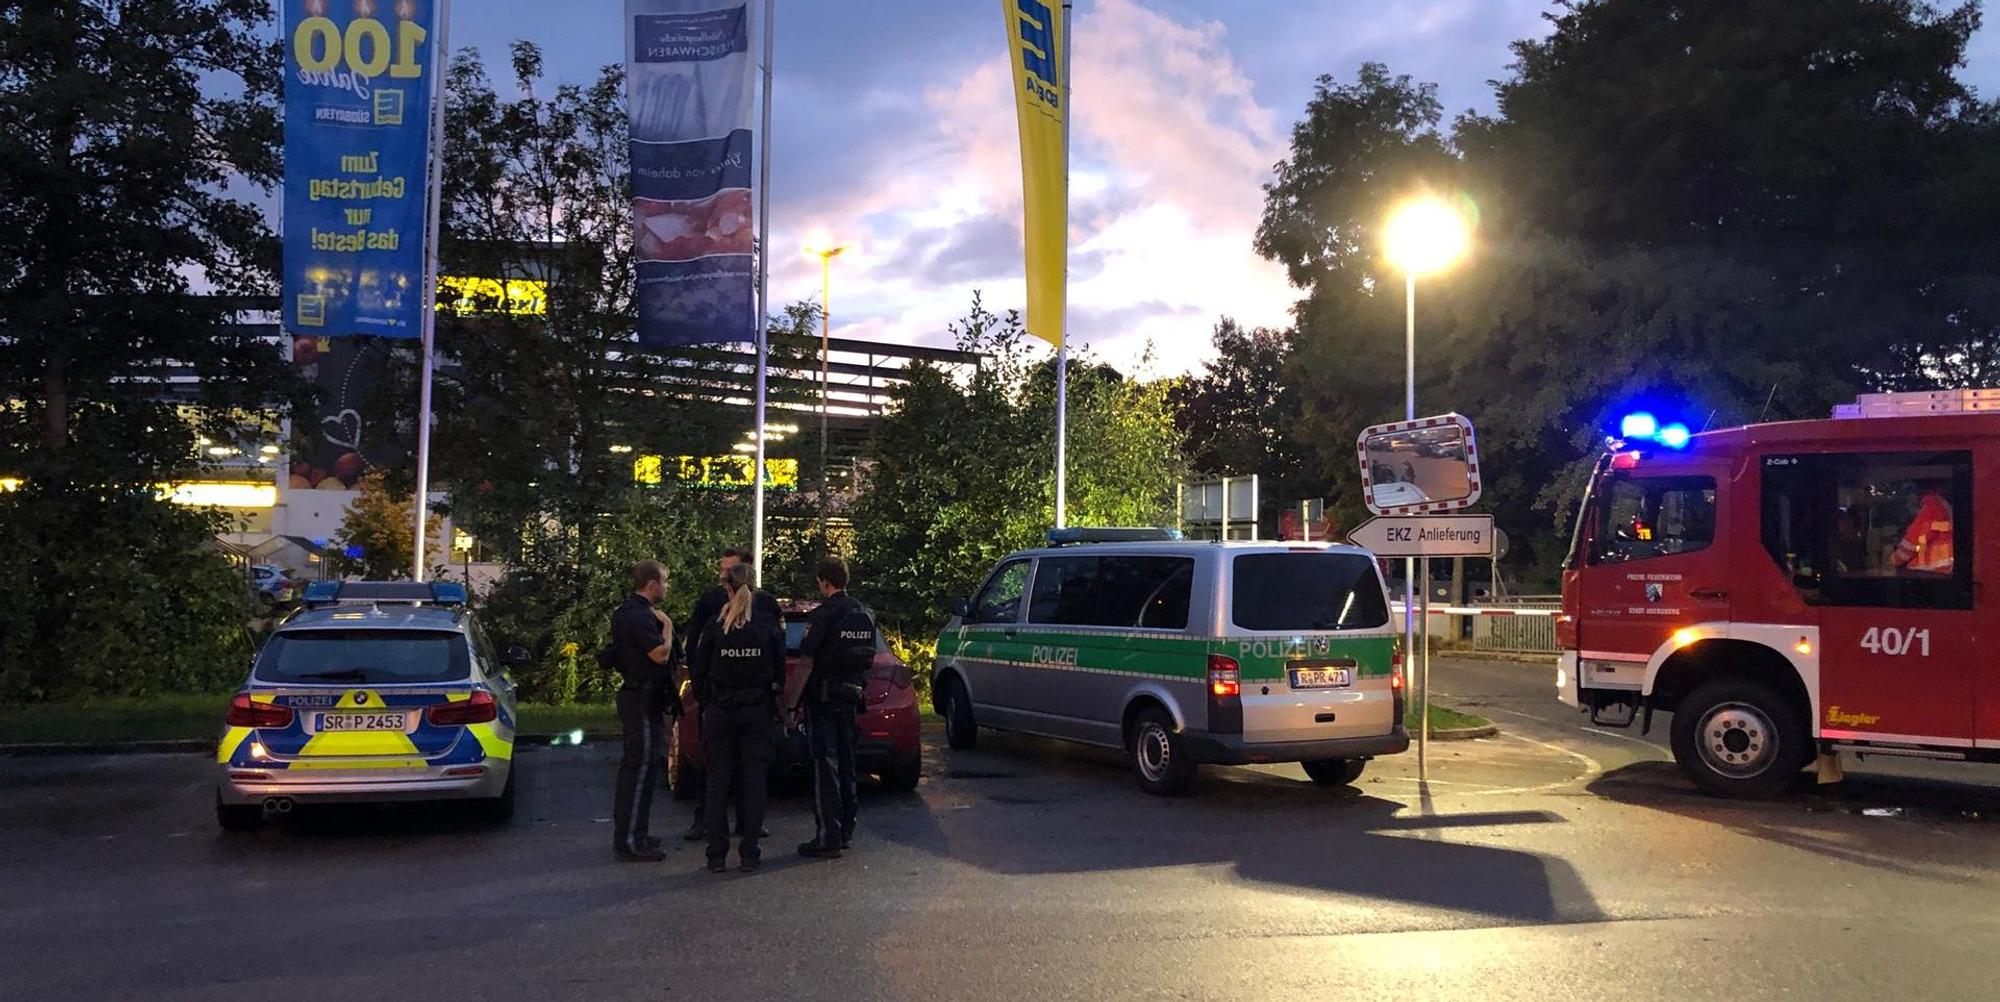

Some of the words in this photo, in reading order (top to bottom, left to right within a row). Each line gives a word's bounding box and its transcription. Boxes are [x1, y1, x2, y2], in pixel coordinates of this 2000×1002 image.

[1386, 527, 1412, 542] EKZ
[1417, 526, 1480, 544] Anlieferung
[840, 630, 872, 640] POLIZEI
[1860, 626, 1930, 657] 40/1
[720, 648, 761, 658] POLIZEI
[1032, 645, 1079, 666] POLIZEI
[1240, 640, 1312, 659] POLIZEI
[1300, 672, 1308, 684] R
[1313, 671, 1326, 684] PR
[287, 696, 333, 707] POLIZEI
[324, 715, 343, 730] SR
[354, 715, 364, 730] P
[366, 714, 403, 730] 2453
